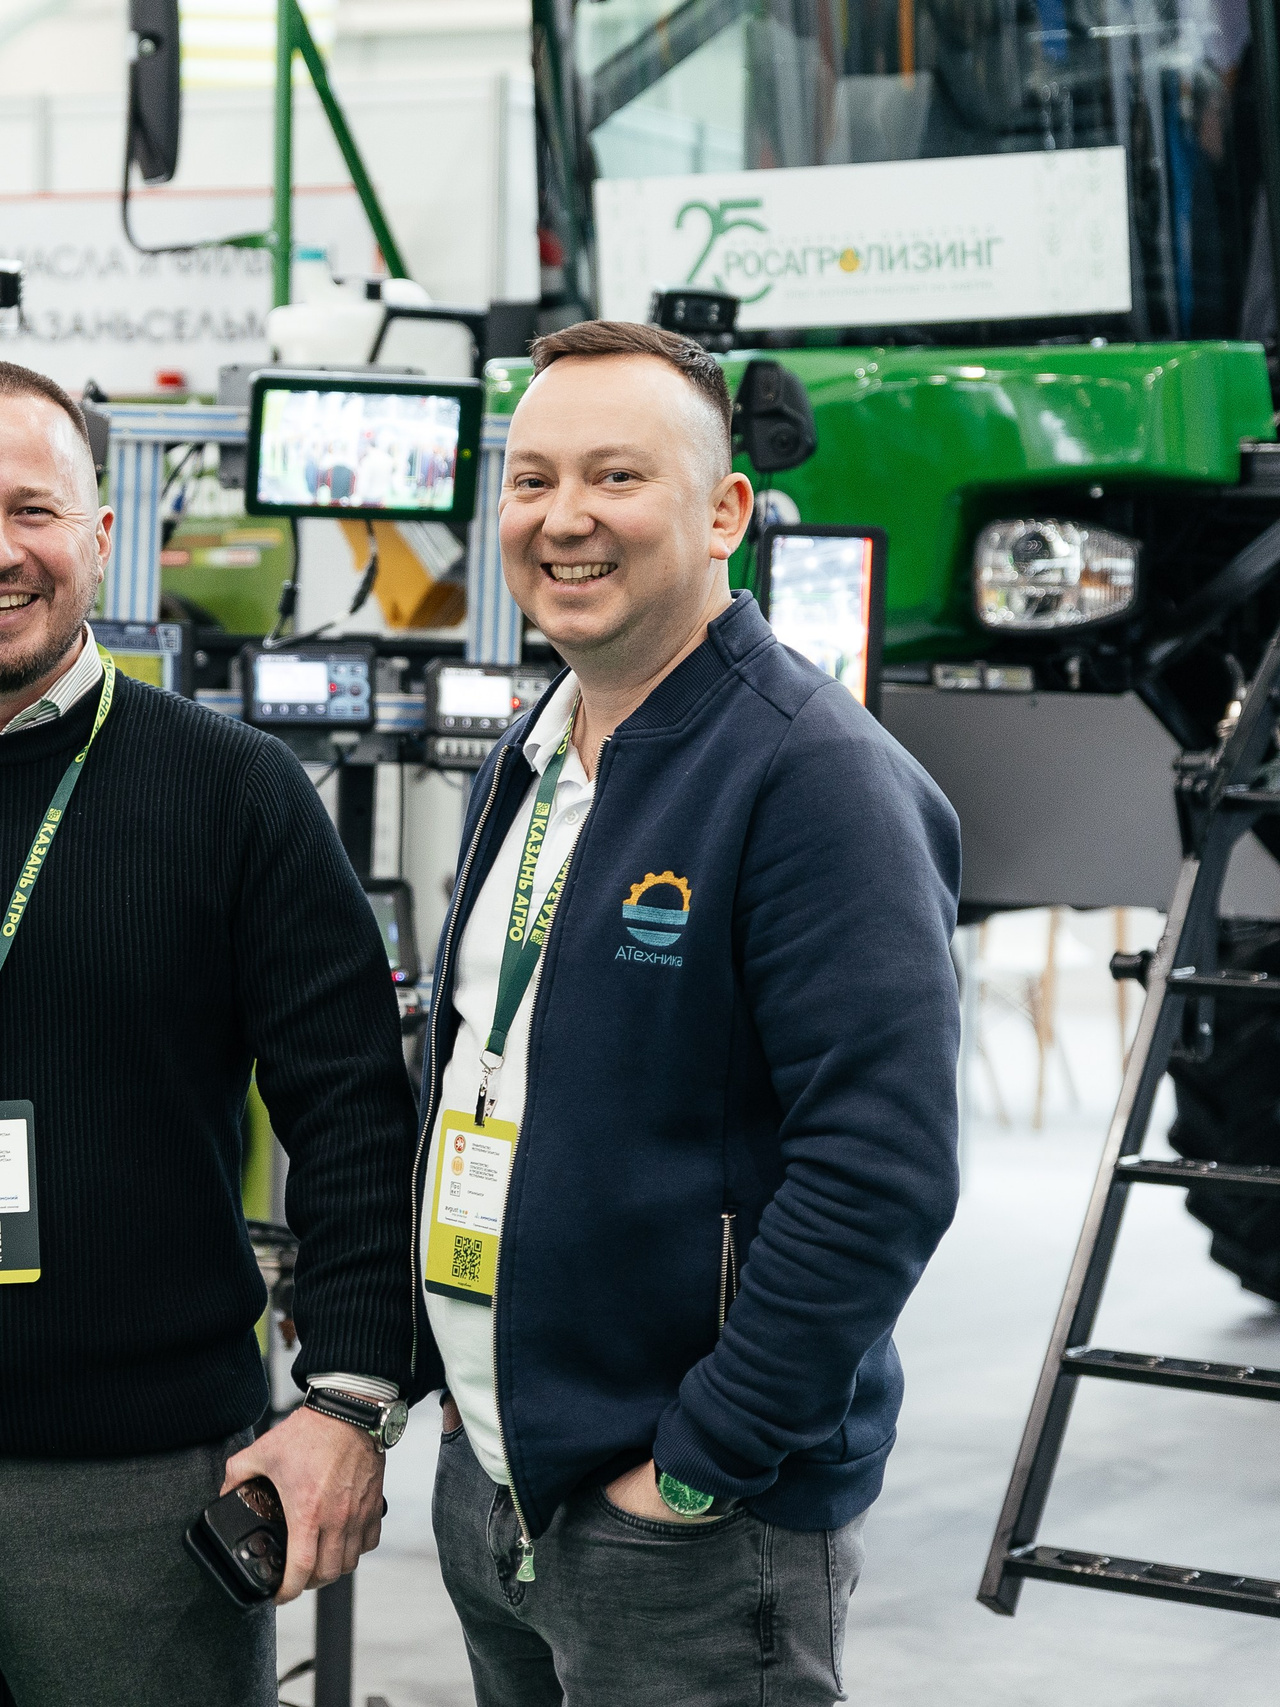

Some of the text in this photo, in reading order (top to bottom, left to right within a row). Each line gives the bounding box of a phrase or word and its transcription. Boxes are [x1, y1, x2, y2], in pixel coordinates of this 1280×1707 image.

[674, 197, 773, 304] 25
[723, 236, 1004, 279] РОСАГРОЛИЗИНГ
[1, 822, 57, 938] КАЗАНЬ АГРО
[508, 817, 548, 942] КАЗАНЬ АГРО
[536, 860, 570, 928] КАЗАН
[614, 945, 683, 967] АТехника
